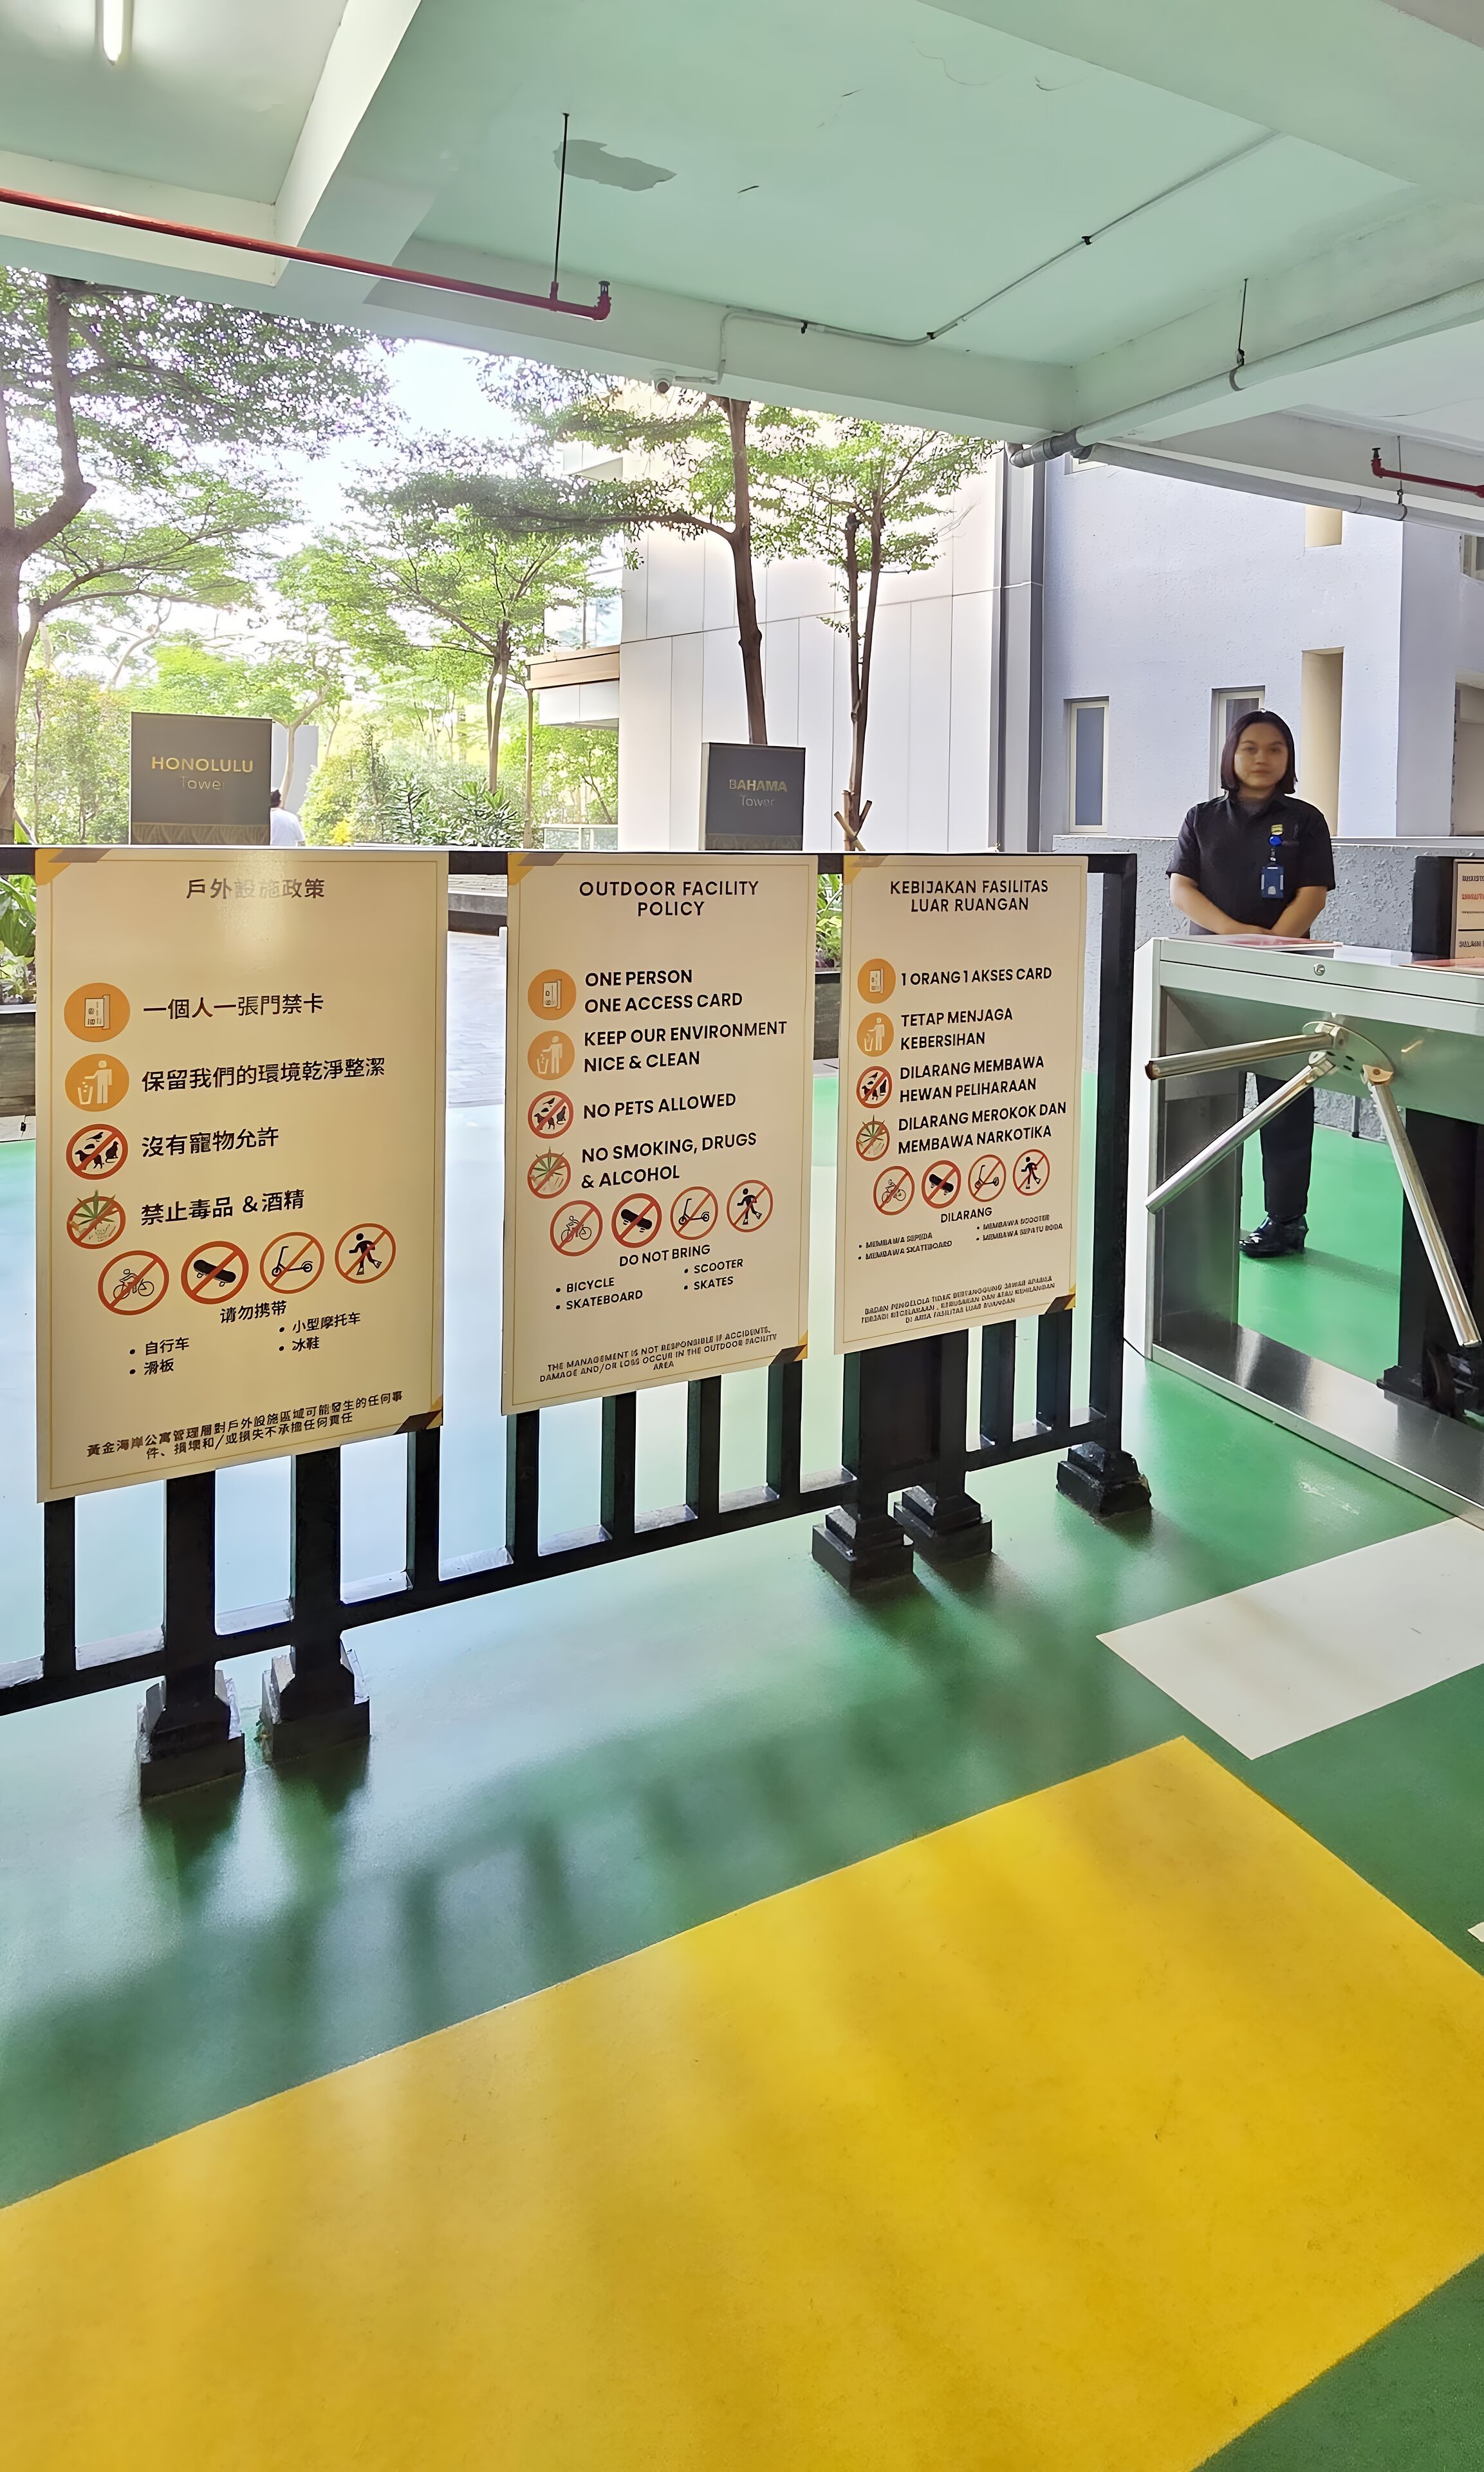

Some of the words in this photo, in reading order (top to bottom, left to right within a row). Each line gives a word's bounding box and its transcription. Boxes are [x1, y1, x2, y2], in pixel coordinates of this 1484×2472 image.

[151, 756, 254, 773] HONOLULU
[729, 780, 788, 792] BAHAMA
[740, 795, 775, 806] Tower
[579, 881, 675, 896] OUTDOOR
[682, 881, 759, 895] FACILITY
[890, 880, 976, 894] KEBIJAKAN
[983, 880, 1048, 893] FASILITAS
[638, 901, 705, 917] POLICY
[911, 899, 949, 912] LUAR
[954, 897, 1028, 911] RUANGAN
[585, 973, 621, 986] ONE
[626, 969, 692, 985] PERSON
[902, 973, 906, 986] 1
[910, 971, 960, 985] ORANG
[964, 970, 968, 983] 1
[972, 969, 1013, 982] AKSES
[1016, 968, 1052, 980] CARD
[144, 993, 323, 1018] 一個人一張門禁卡
[585, 998, 621, 1013] ONE
[625, 995, 692, 1011] ACCESS
[697, 993, 743, 1008] CARD
[901, 1013, 944, 1027] TETAP
[947, 1008, 1013, 1024] MENJAGA
[584, 1031, 626, 1046] KEEP
[631, 1029, 666, 1044] OUR
[671, 1021, 787, 1042] ENVIRONMENT
[901, 1033, 985, 1050] KEBERSIHAN
[584, 1056, 624, 1072] NICE
[629, 1056, 642, 1069] &
[646, 1051, 700, 1068] CLEAN
[900, 1062, 970, 1079] DILARANG
[974, 1056, 1044, 1073] MEMBAWA
[142, 1057, 384, 1092] 保留我們的環境乾淨整潔
[900, 1084, 952, 1102] HEWAN
[956, 1078, 1036, 1097] PELIHARAAN
[583, 1104, 610, 1119] NO
[615, 1100, 654, 1116] PETS
[658, 1093, 736, 1113] ALLOWED
[899, 1112, 969, 1130] DILARANG
[972, 1105, 1036, 1123] MEROKOK
[1039, 1102, 1066, 1116] DAN
[142, 1127, 279, 1157] 沒有寵物允許
[582, 1148, 608, 1163] NO
[613, 1139, 697, 1160] SMOKING,
[702, 1132, 757, 1150] DRUGS
[898, 1135, 973, 1154] MEMBAWA
[977, 1125, 1052, 1145] NARKOTIKA
[581, 1175, 595, 1188] &
[599, 1165, 680, 1187] ALCOHOL
[140, 1196, 234, 1226] 禁止毒品
[940, 1207, 992, 1222] DILARANG
[619, 1255, 638, 1267] DO
[642, 1250, 669, 1264] NOT
[671, 1244, 710, 1260] BRING
[694, 1259, 743, 1274] SCOOTER
[567, 1277, 615, 1293] BICYCLE
[694, 1277, 734, 1290] SKATES
[566, 1290, 643, 1310] SKATEBOARD
[220, 1300, 286, 1324] 请勿携带
[144, 1337, 190, 1356] 自行车
[292, 1336, 320, 1351] 冰鞋
[641, 1346, 658, 1354] NOT
[704, 1340, 743, 1352] OUTDOOR
[144, 1359, 174, 1376] 滑板
[653, 1361, 674, 1370] AREA
